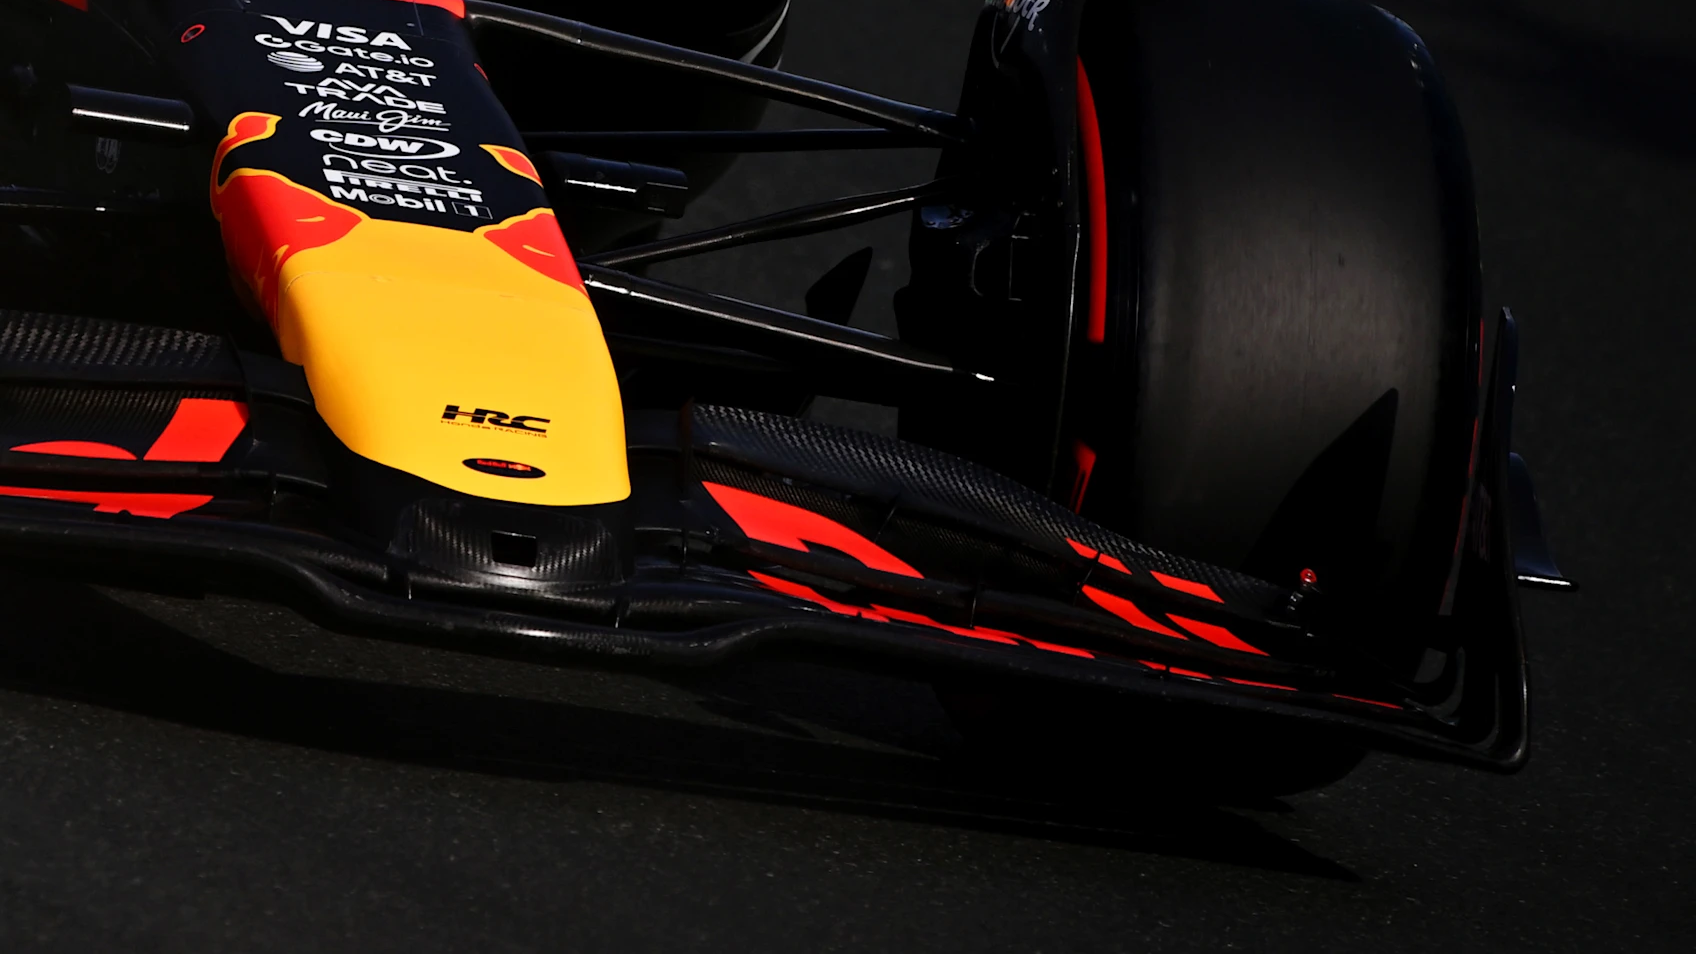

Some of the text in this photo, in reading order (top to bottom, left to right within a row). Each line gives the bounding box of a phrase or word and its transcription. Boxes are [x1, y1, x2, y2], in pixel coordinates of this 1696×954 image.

[260, 13, 413, 52] VISA
[293, 39, 435, 69] Gate.io
[317, 77, 408, 98] AVA
[335, 62, 438, 88] AT&T
[284, 81, 448, 115] TRADE
[297, 100, 451, 133] Maui Jim
[309, 128, 426, 155] CDW
[322, 168, 484, 203] PIRELLI
[329, 185, 447, 213] Mobil
[441, 404, 551, 434] HRC
